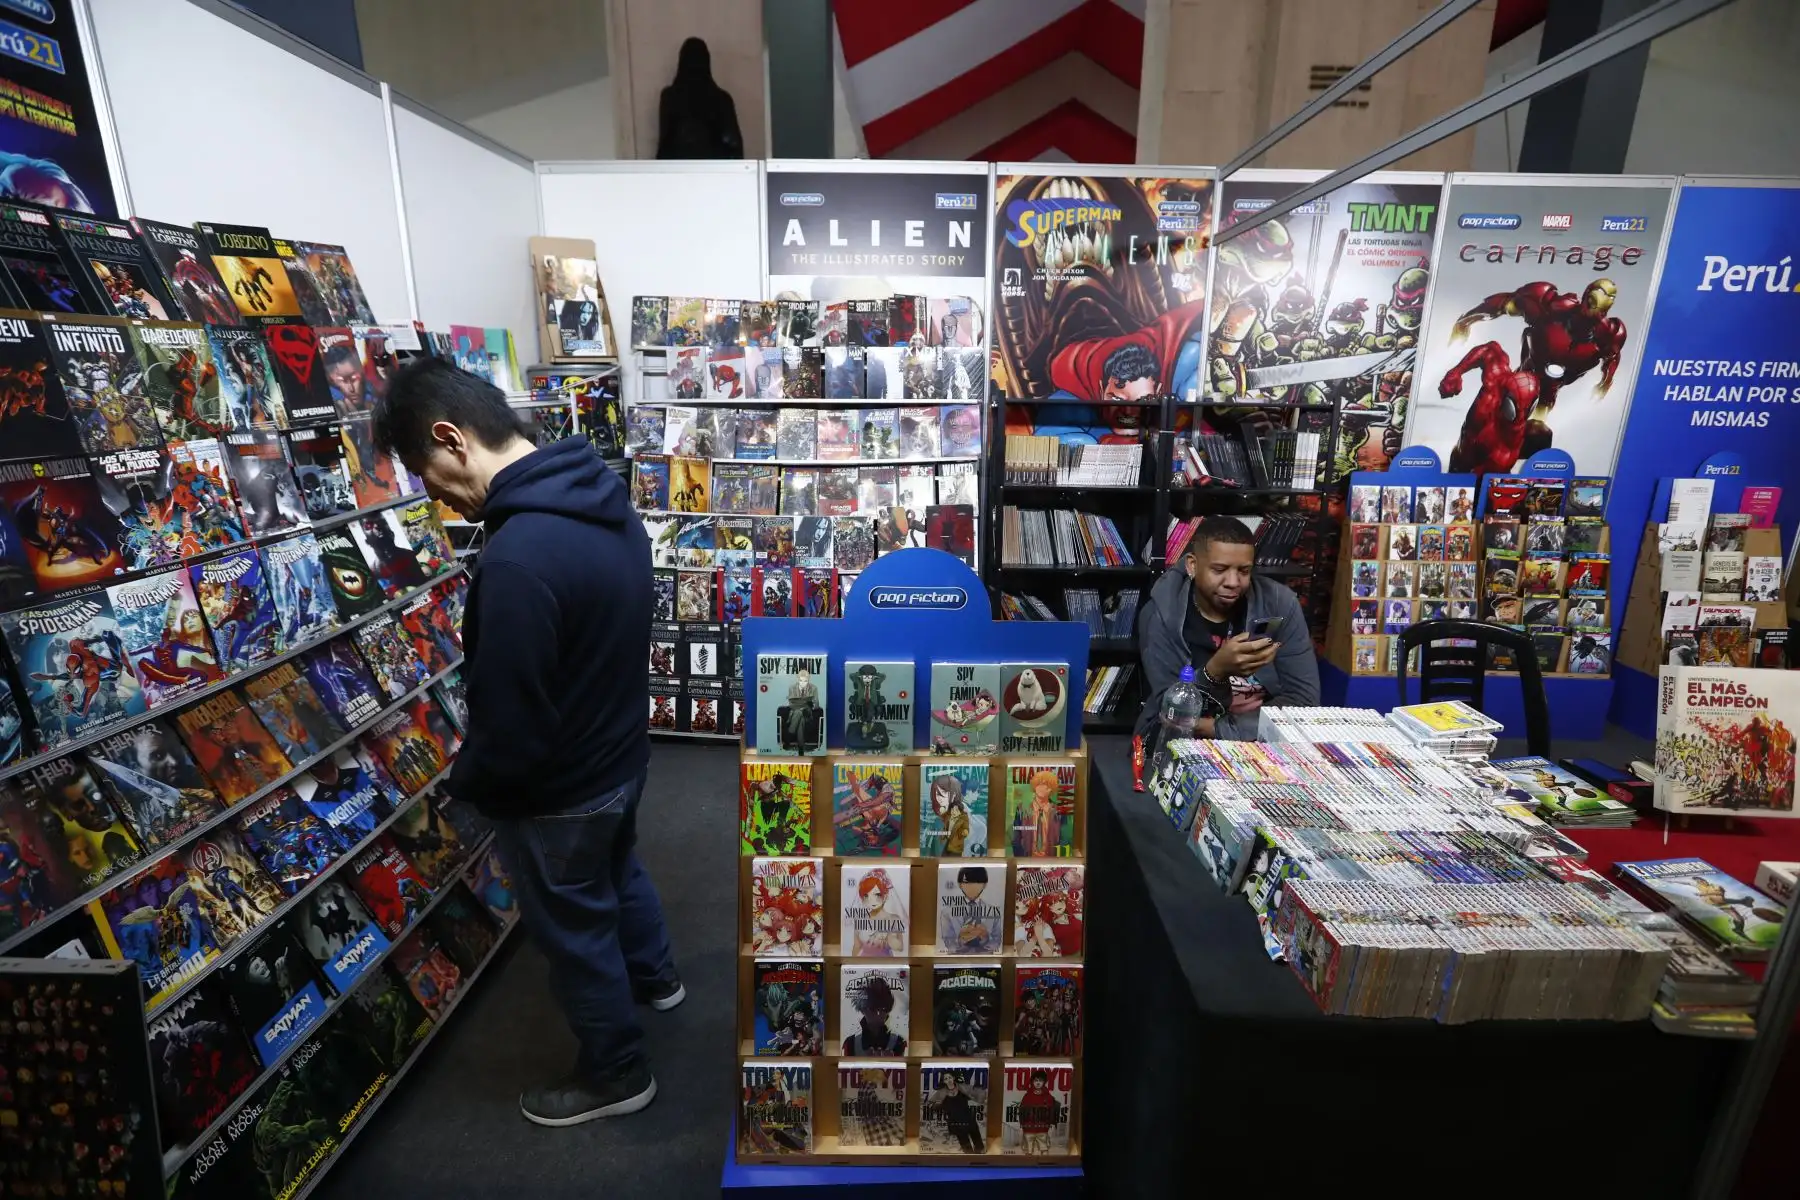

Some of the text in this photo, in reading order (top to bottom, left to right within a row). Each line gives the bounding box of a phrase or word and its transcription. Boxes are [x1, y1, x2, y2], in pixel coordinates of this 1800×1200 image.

[0, 32, 60, 67] rú21
[937, 195, 975, 207] Perú21
[1019, 207, 1122, 247] SUPERMAN
[1348, 203, 1435, 233] TMNT
[1462, 217, 1517, 226] pop fiction
[1542, 215, 1571, 228] MARVEL
[1602, 218, 1645, 230] Perú21
[152, 232, 199, 249] LOBEZNO
[216, 232, 269, 251] LOBEZNO
[783, 219, 971, 248] ALIEN
[70, 234, 142, 257] AVENGERS
[1044, 234, 1196, 265] ALIENS
[1358, 248, 1385, 256] CÓMIC
[792, 253, 965, 265] THE ILLUSTRATED STORY
[1362, 259, 1400, 267] VOLUMEN
[1459, 243, 1643, 271] carnage
[1697, 255, 1800, 293] Perú
[1, 319, 35, 338] EVIL
[106, 326, 119, 334] DEL
[54, 331, 126, 353] INFINITO
[1653, 360, 1800, 379] NUESTRAS FIRM
[1664, 385, 1800, 403] HABLAN POR S
[292, 406, 335, 418] SUPERMAN
[1691, 410, 1770, 428] MISMAS
[100, 455, 118, 465] LOS
[119, 450, 160, 463] MEJORES
[106, 458, 160, 474] DEL MUNDO
[269, 540, 312, 564] SPIDERMAN
[146, 563, 183, 576] MARVEL SAGA
[202, 558, 253, 584] SPIDERMAN
[54, 584, 102, 599] MARVEL SAGA
[117, 577, 184, 609] SPIDERMAN
[877, 591, 960, 603] pop fiction
[28, 599, 84, 618] ASOMBROSO
[19, 601, 103, 636] SPIDERMAN
[359, 616, 394, 636] MOORE
[761, 658, 822, 675] SPY FAMILY
[957, 667, 974, 681] SPY
[950, 687, 981, 701] FAMILY
[1687, 682, 1747, 695] EL MÁS
[1687, 694, 1769, 709] CAMPEÓN
[1002, 736, 1062, 753] SPY FAMILY
[326, 784, 378, 829] NIGHTWING
[942, 896, 968, 907] SOMOS
[845, 908, 872, 919] SOMOS
[334, 932, 376, 973] BATMAN
[845, 976, 905, 991] ACAMIA
[938, 976, 996, 990] ACADEMIA
[149, 990, 203, 1040] ATMAN
[264, 993, 312, 1044] BATMAN
[295, 1040, 322, 1071] MOORE
[838, 1068, 905, 1089] TOYO
[921, 1067, 988, 1091] TOYO
[339, 1072, 390, 1133] SWAMP THING
[227, 1105, 252, 1136] ALAN
[229, 1104, 264, 1141] MOORE
[196, 1137, 225, 1168] ALAN
[306, 1136, 336, 1166] THING
[189, 1143, 229, 1184] MOORE
